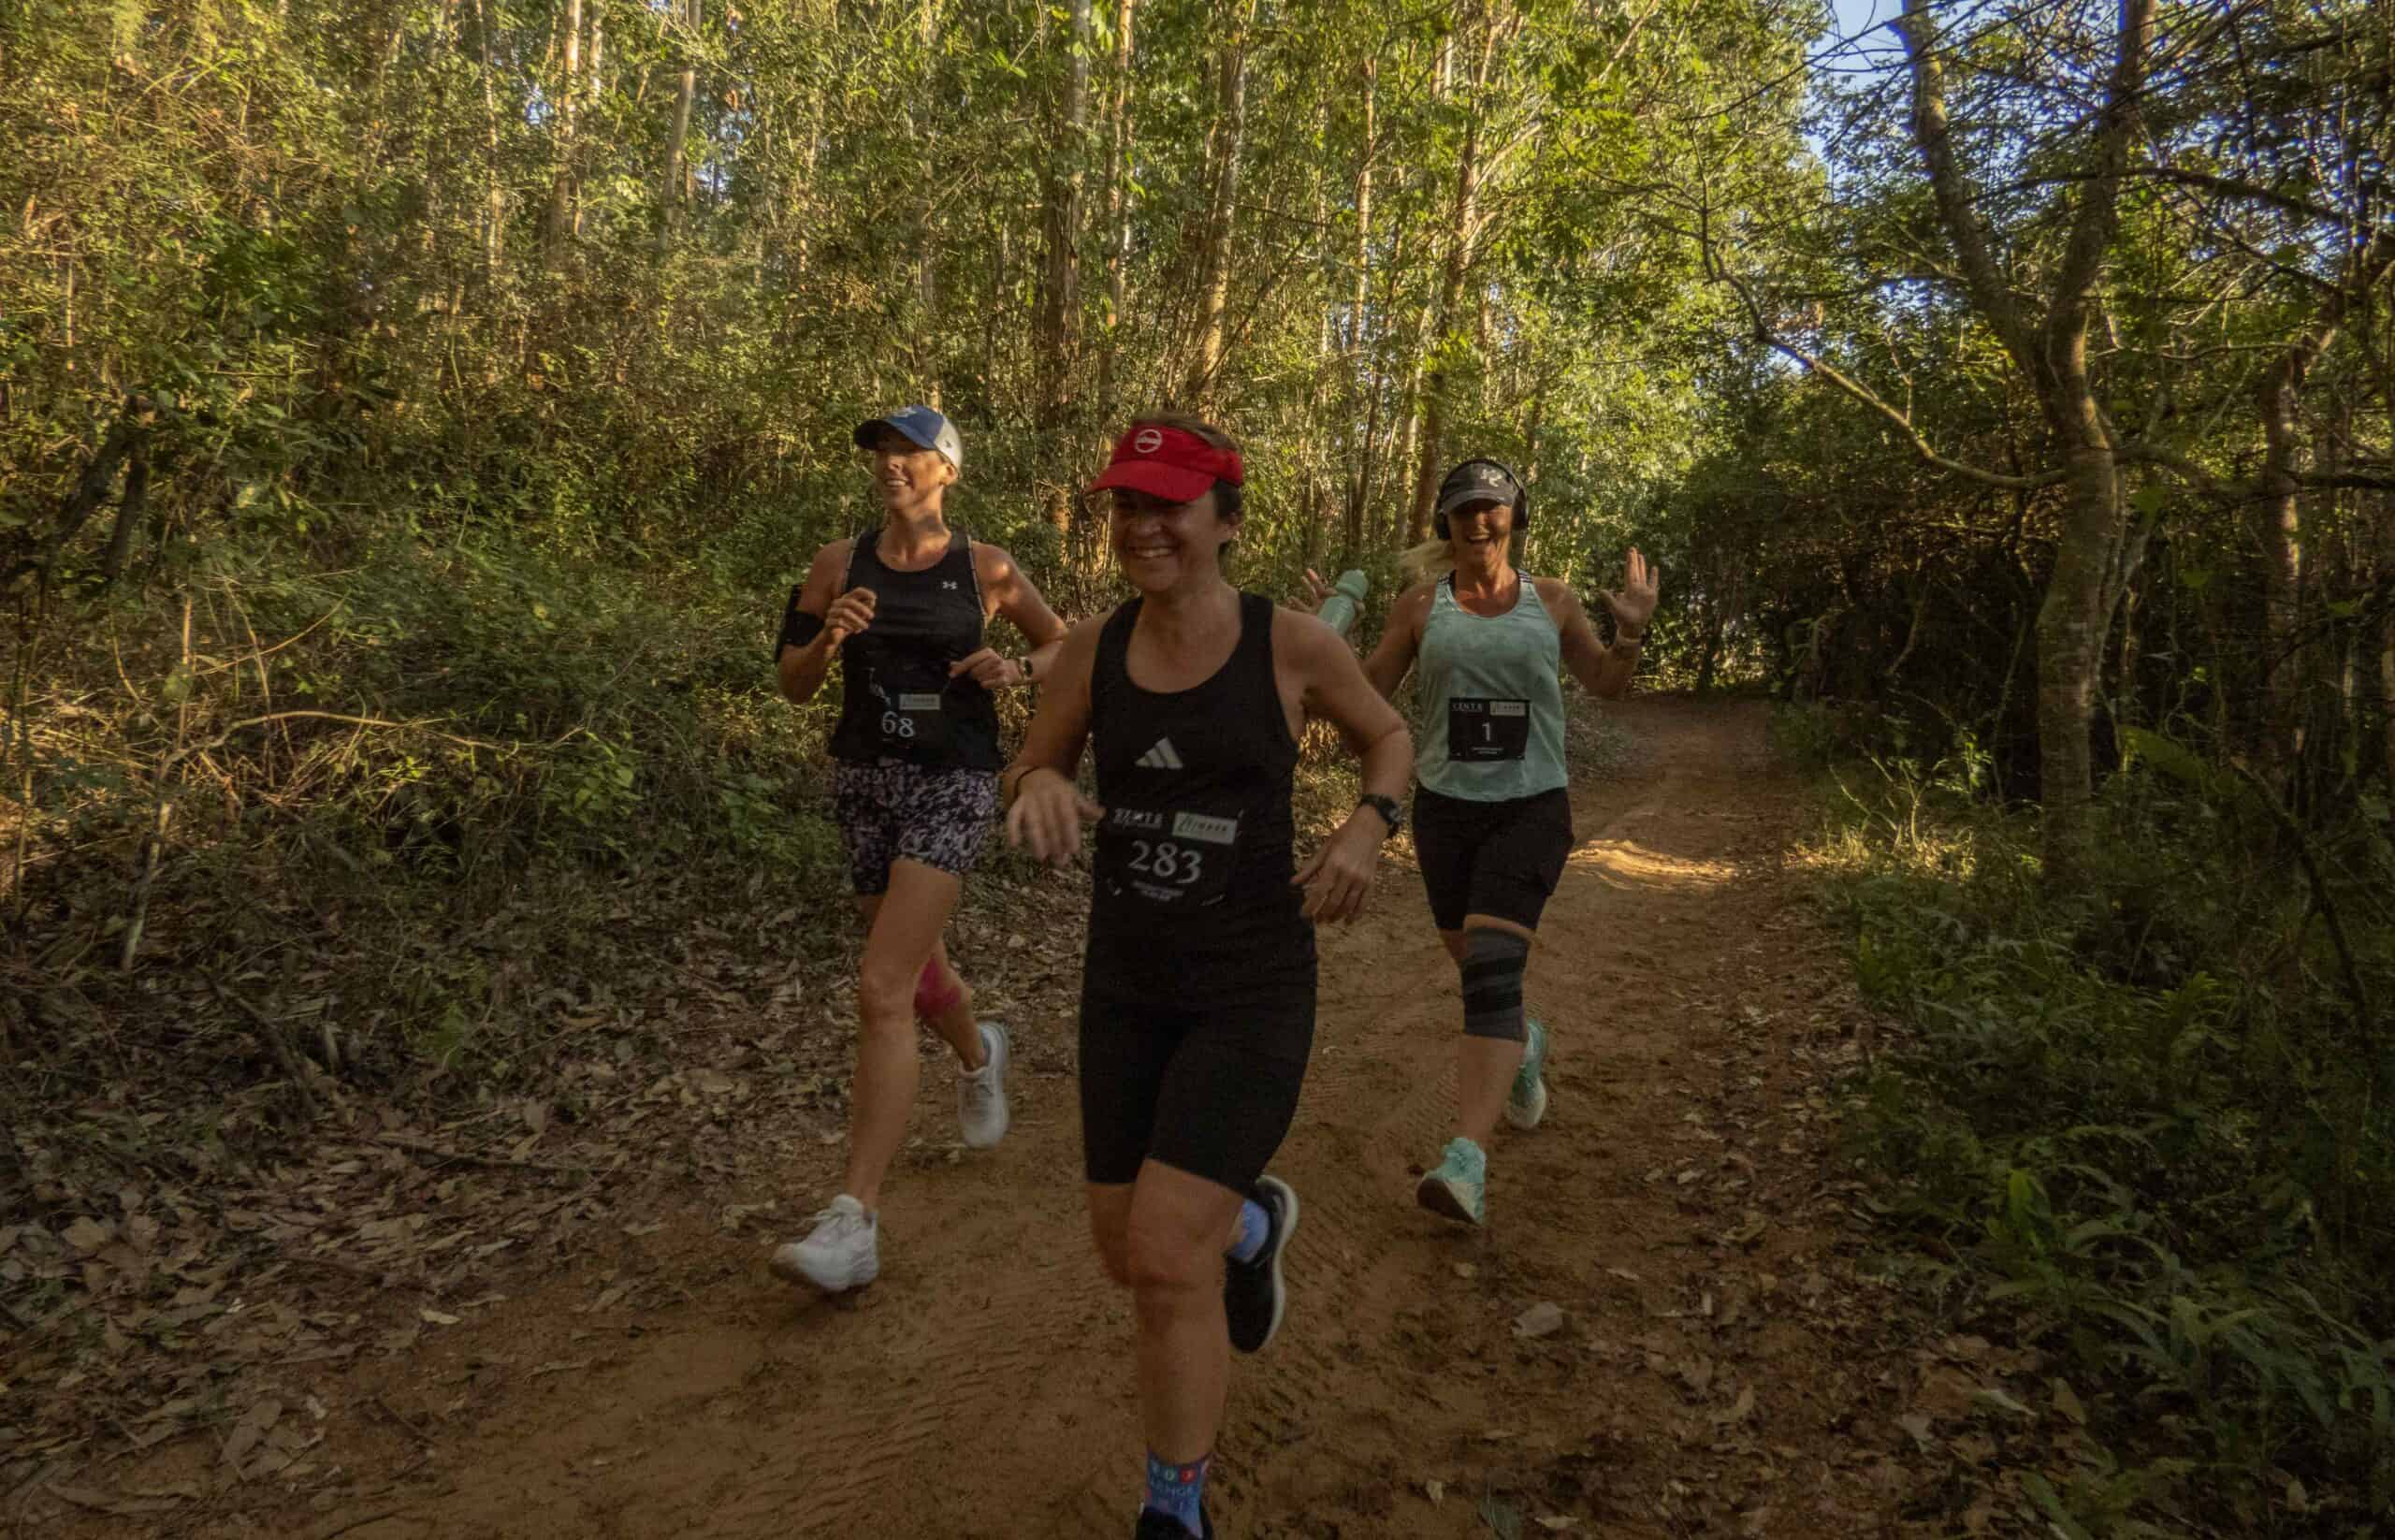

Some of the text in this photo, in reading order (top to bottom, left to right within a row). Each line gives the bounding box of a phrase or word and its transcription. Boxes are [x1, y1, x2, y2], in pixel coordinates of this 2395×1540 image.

[882, 711, 915, 737] 68
[1481, 721, 1492, 742] 1
[1127, 839, 1203, 884] 283
